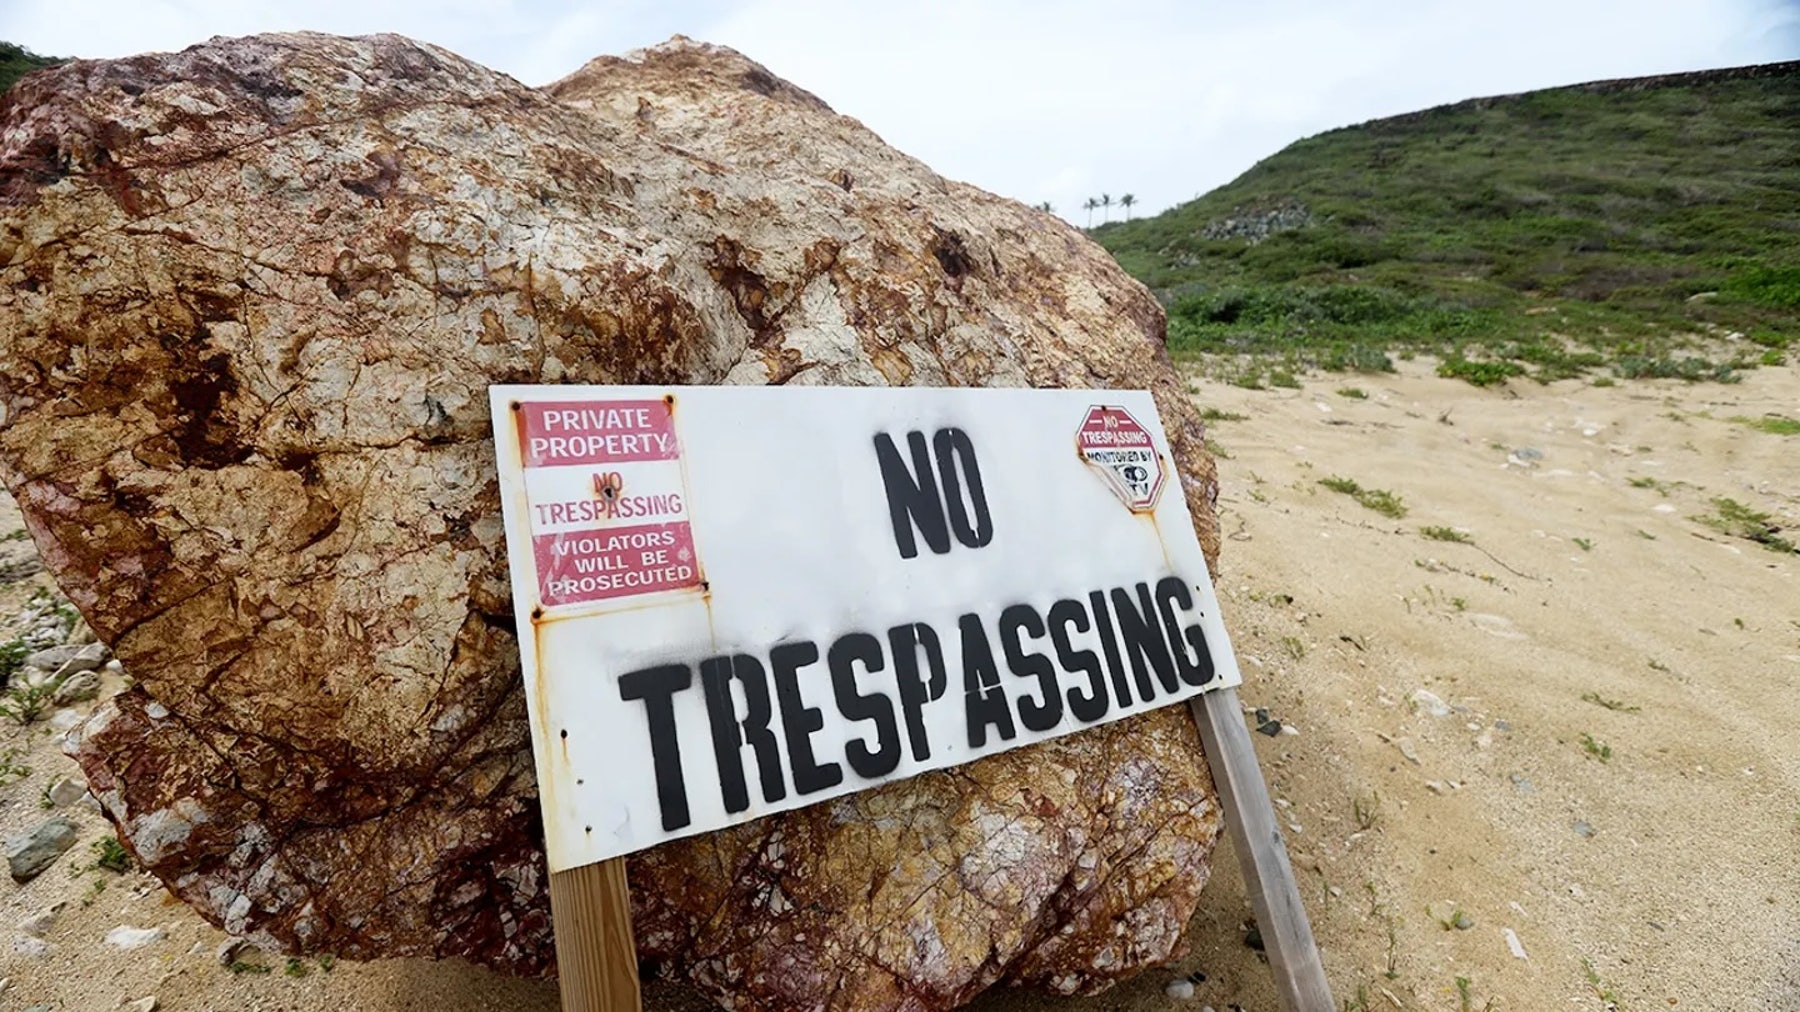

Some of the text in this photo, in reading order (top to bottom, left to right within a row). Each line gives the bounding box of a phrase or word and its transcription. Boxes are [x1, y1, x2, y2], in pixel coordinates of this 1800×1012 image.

[543, 408, 652, 431] PRIVATE
[1103, 415, 1118, 428] NO
[531, 434, 668, 458] PROPERTY
[1081, 431, 1147, 444] TRESPASSING
[1087, 451, 1152, 463] MONITORED BY
[592, 471, 623, 494] NO
[873, 427, 994, 560] NO
[535, 495, 681, 524] TRESPASSING
[555, 531, 675, 556] VIOLATORS
[574, 550, 669, 574] WILL BE
[548, 565, 692, 597] PROSECUTED
[618, 576, 1215, 832] TRESPASSING
